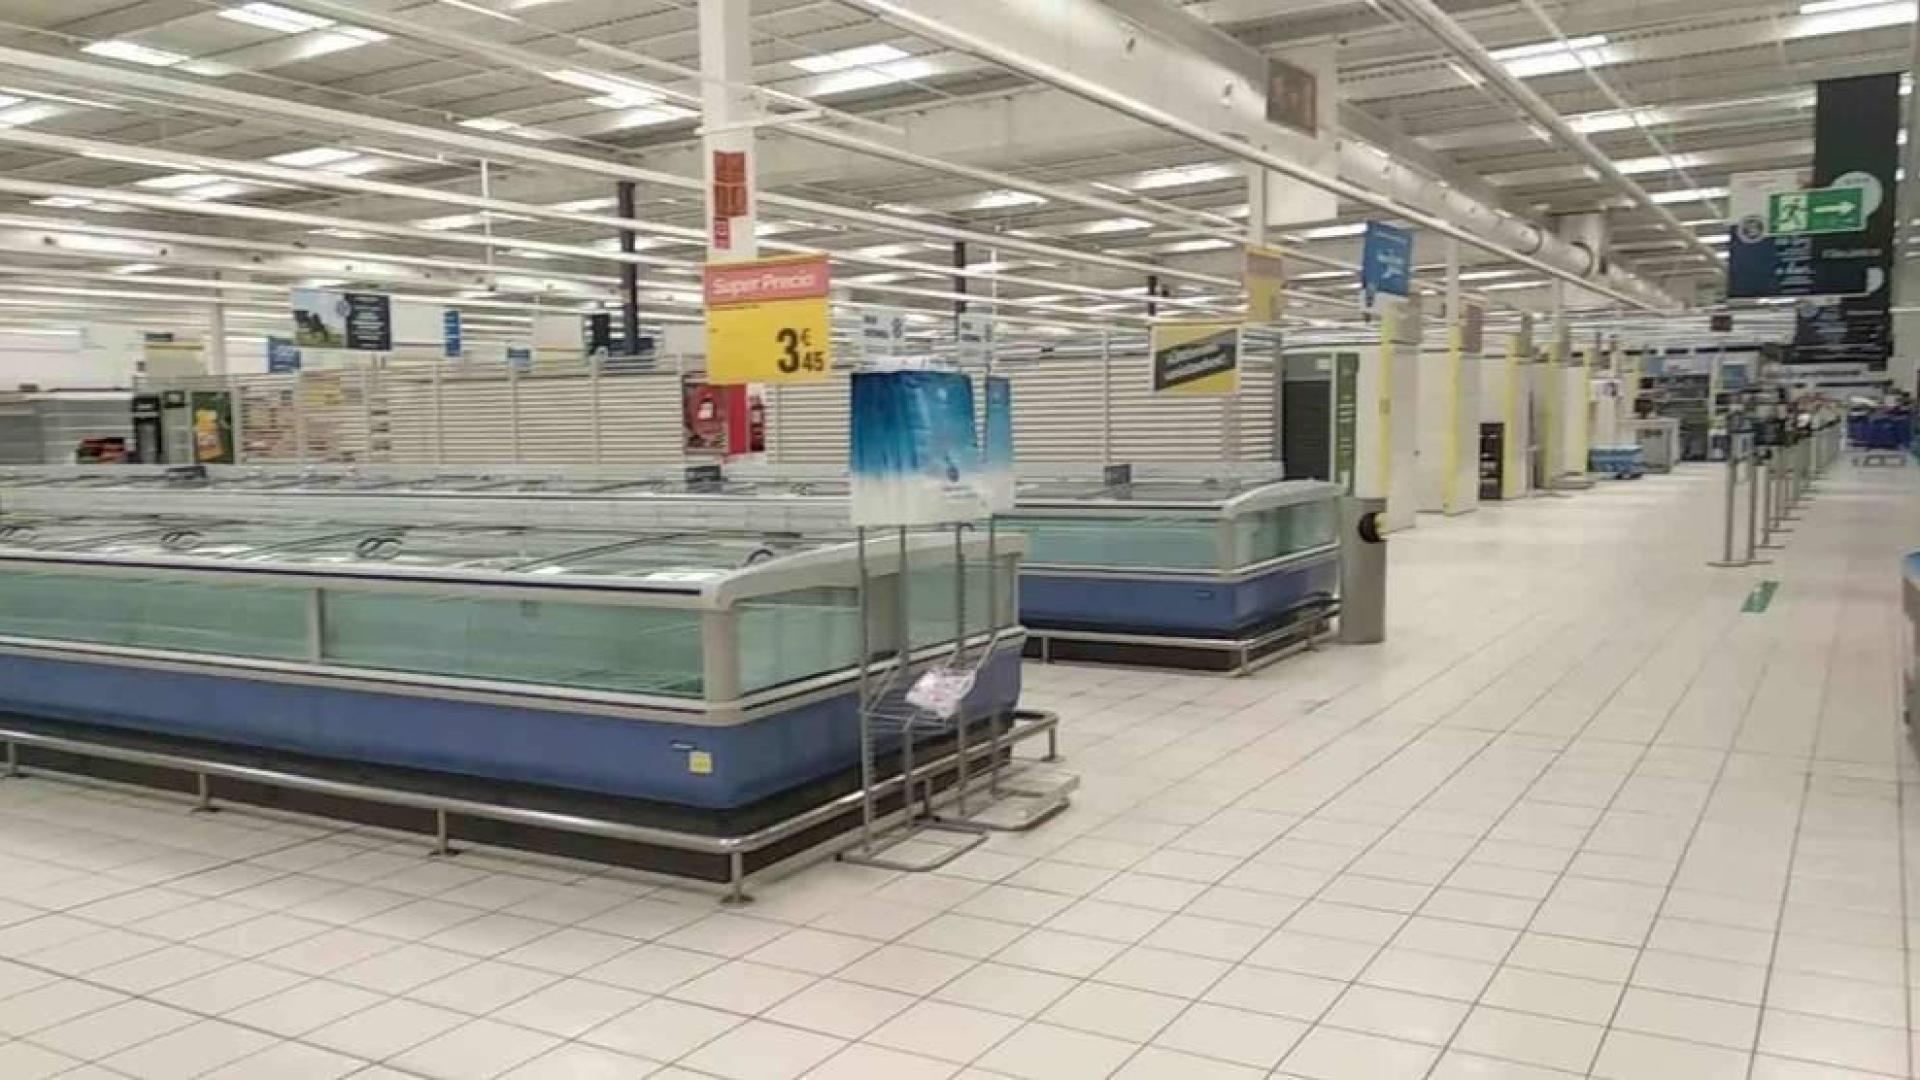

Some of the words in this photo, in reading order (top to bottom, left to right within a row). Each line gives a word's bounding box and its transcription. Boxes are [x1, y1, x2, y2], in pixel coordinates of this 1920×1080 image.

[711, 276, 761, 297] Super
[776, 327, 800, 374] 3
[802, 351, 825, 372] 45
